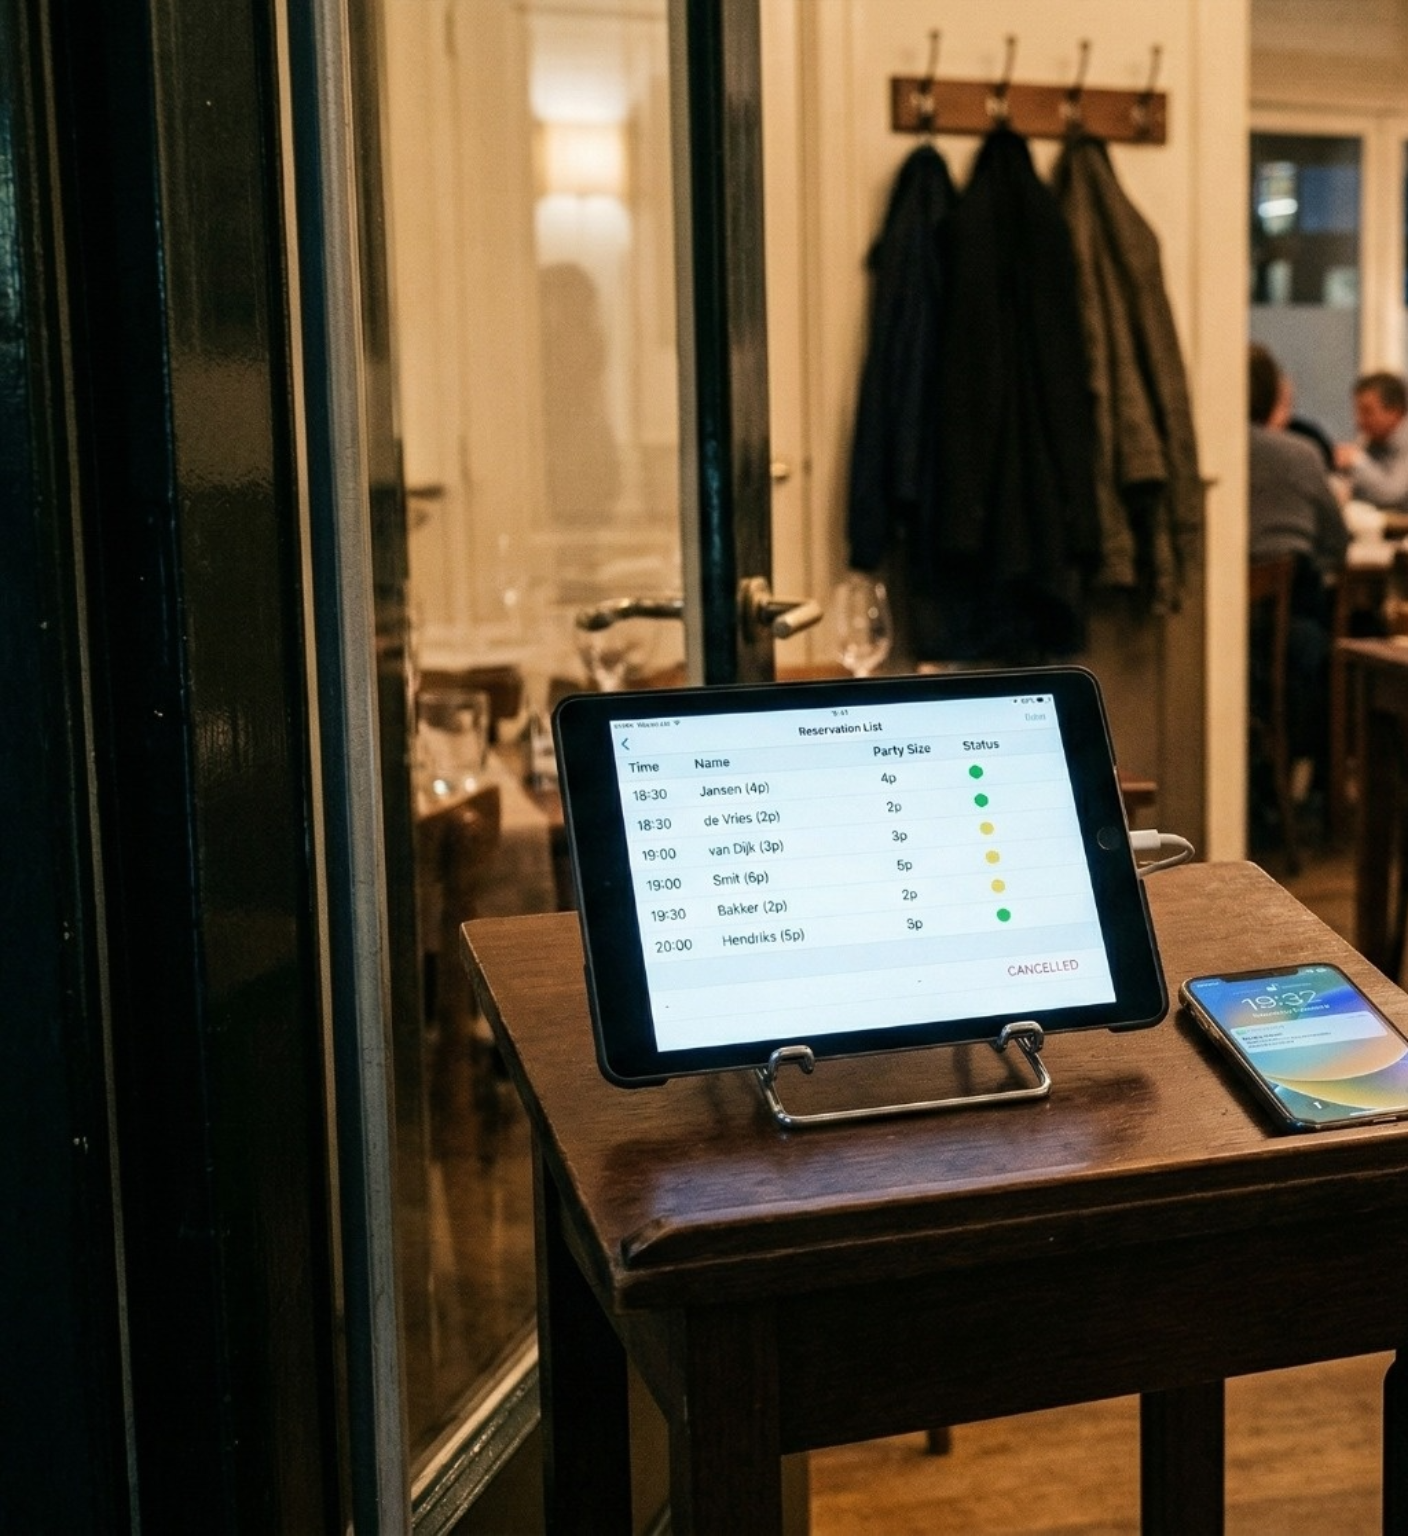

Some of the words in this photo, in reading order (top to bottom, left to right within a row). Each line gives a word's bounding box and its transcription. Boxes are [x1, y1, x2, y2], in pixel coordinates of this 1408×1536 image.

[798, 723, 862, 737] Reservation
[863, 721, 883, 733] List
[873, 745, 904, 758] Party
[907, 743, 931, 755] Size
[962, 740, 1000, 751] Status
[628, 761, 660, 773] Time
[694, 758, 731, 769] Name
[881, 772, 897, 785] 4p
[633, 788, 668, 801] 18:30
[699, 784, 742, 798] Jansen
[746, 781, 770, 795] (4p)
[886, 801, 902, 813] 2p
[637, 818, 672, 832] 18:30
[704, 815, 719, 827] de
[721, 813, 753, 825] Vries
[756, 810, 780, 824] (2p)
[891, 830, 908, 843] 3p
[642, 847, 677, 861] 19:00
[708, 846, 731, 857] van
[733, 841, 756, 856] Dijk
[759, 839, 784, 853] (3p)
[897, 859, 913, 872] 5p
[646, 878, 682, 892] 19:00
[712, 872, 741, 887] Smit
[744, 870, 769, 885] (6p)
[901, 889, 918, 901] 2p
[651, 908, 687, 922] 19:30
[717, 902, 759, 917] Bakker
[763, 900, 788, 914] (2p)
[721, 931, 777, 947] Hendriks
[780, 928, 805, 943] (5p)
[655, 939, 693, 954] 20:00
[1007, 959, 1079, 977] CANCELLED
[1241, 989, 1323, 1011] 19:32
